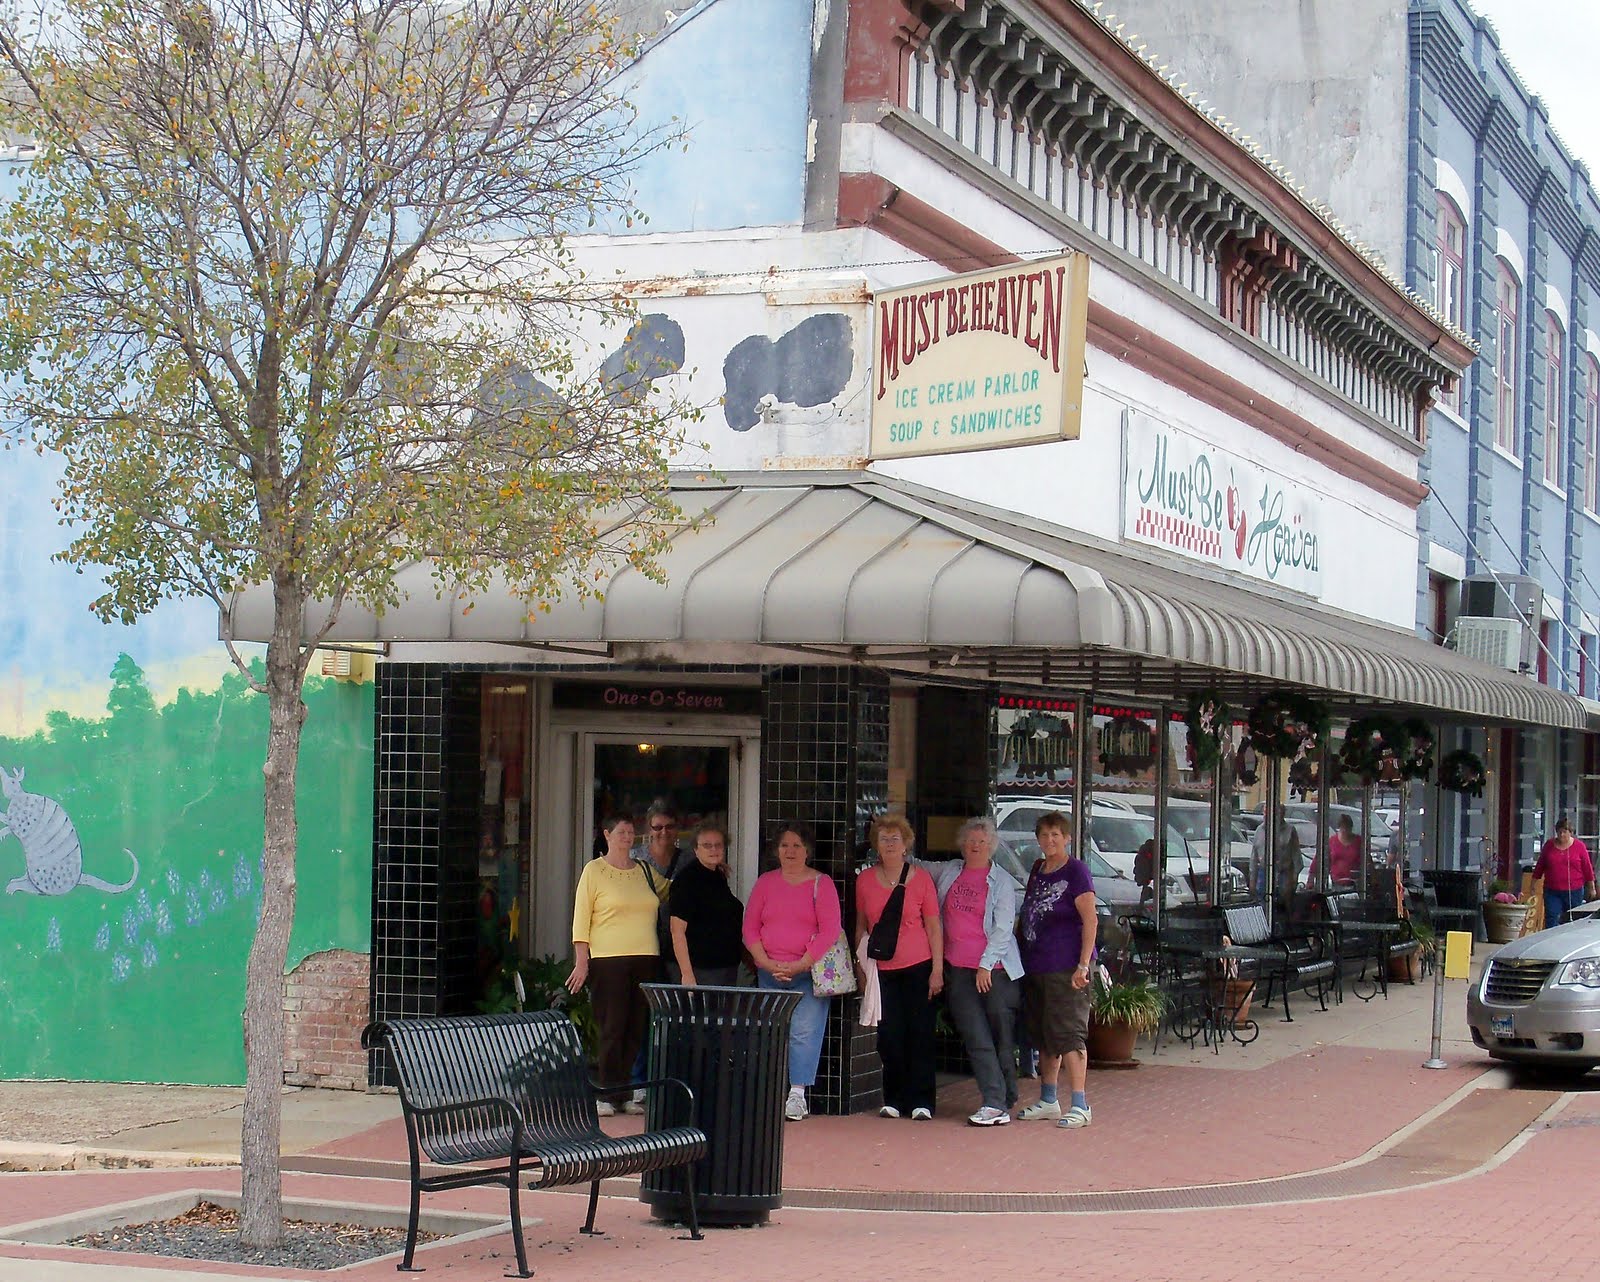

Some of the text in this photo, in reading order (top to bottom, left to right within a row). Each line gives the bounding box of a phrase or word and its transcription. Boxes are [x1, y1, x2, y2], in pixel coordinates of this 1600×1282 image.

[895, 370, 1040, 408] ICE CREAM PARLOR
[889, 420, 923, 442] SOUP
[950, 404, 1042, 435] SANDWICHES
